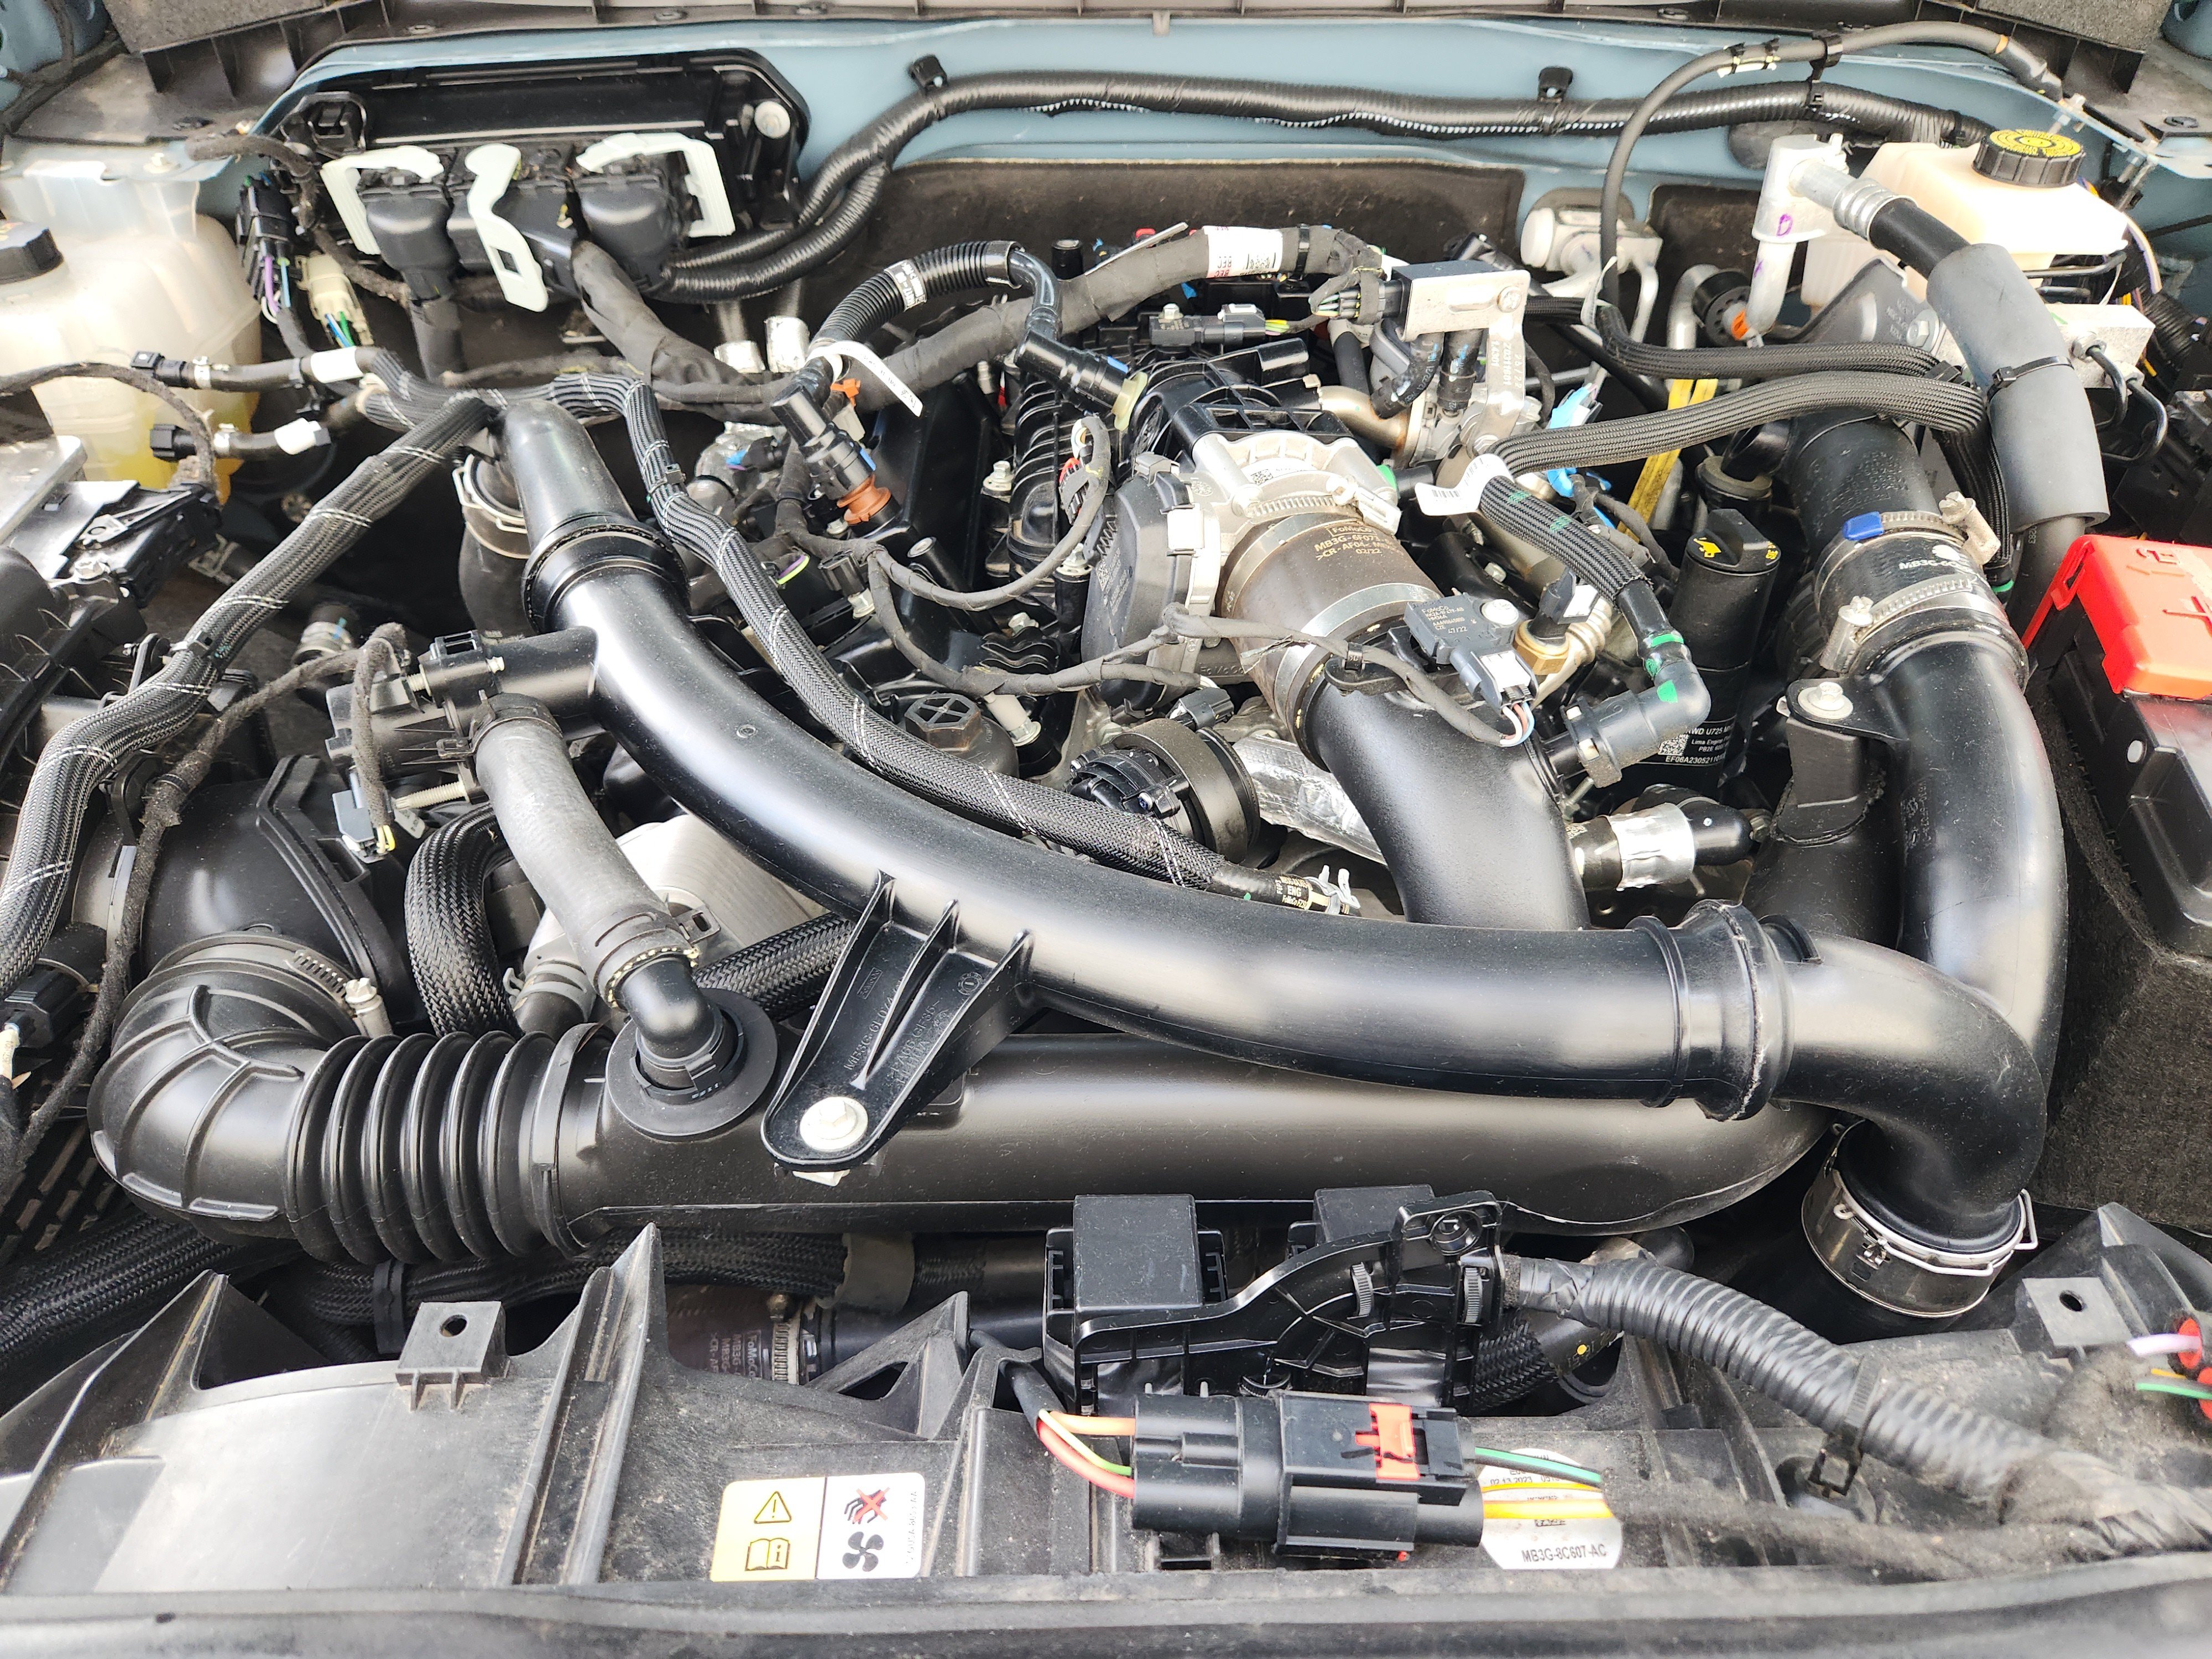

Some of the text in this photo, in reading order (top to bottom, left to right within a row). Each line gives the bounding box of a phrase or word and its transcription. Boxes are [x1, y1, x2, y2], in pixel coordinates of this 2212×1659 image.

[1706, 727, 1723, 735] U725
[1287, 885, 1302, 898] ENG
[747, 1334, 758, 1377] FoMoCo
[1521, 1544, 1607, 1563] MB3G-8C607-AC
